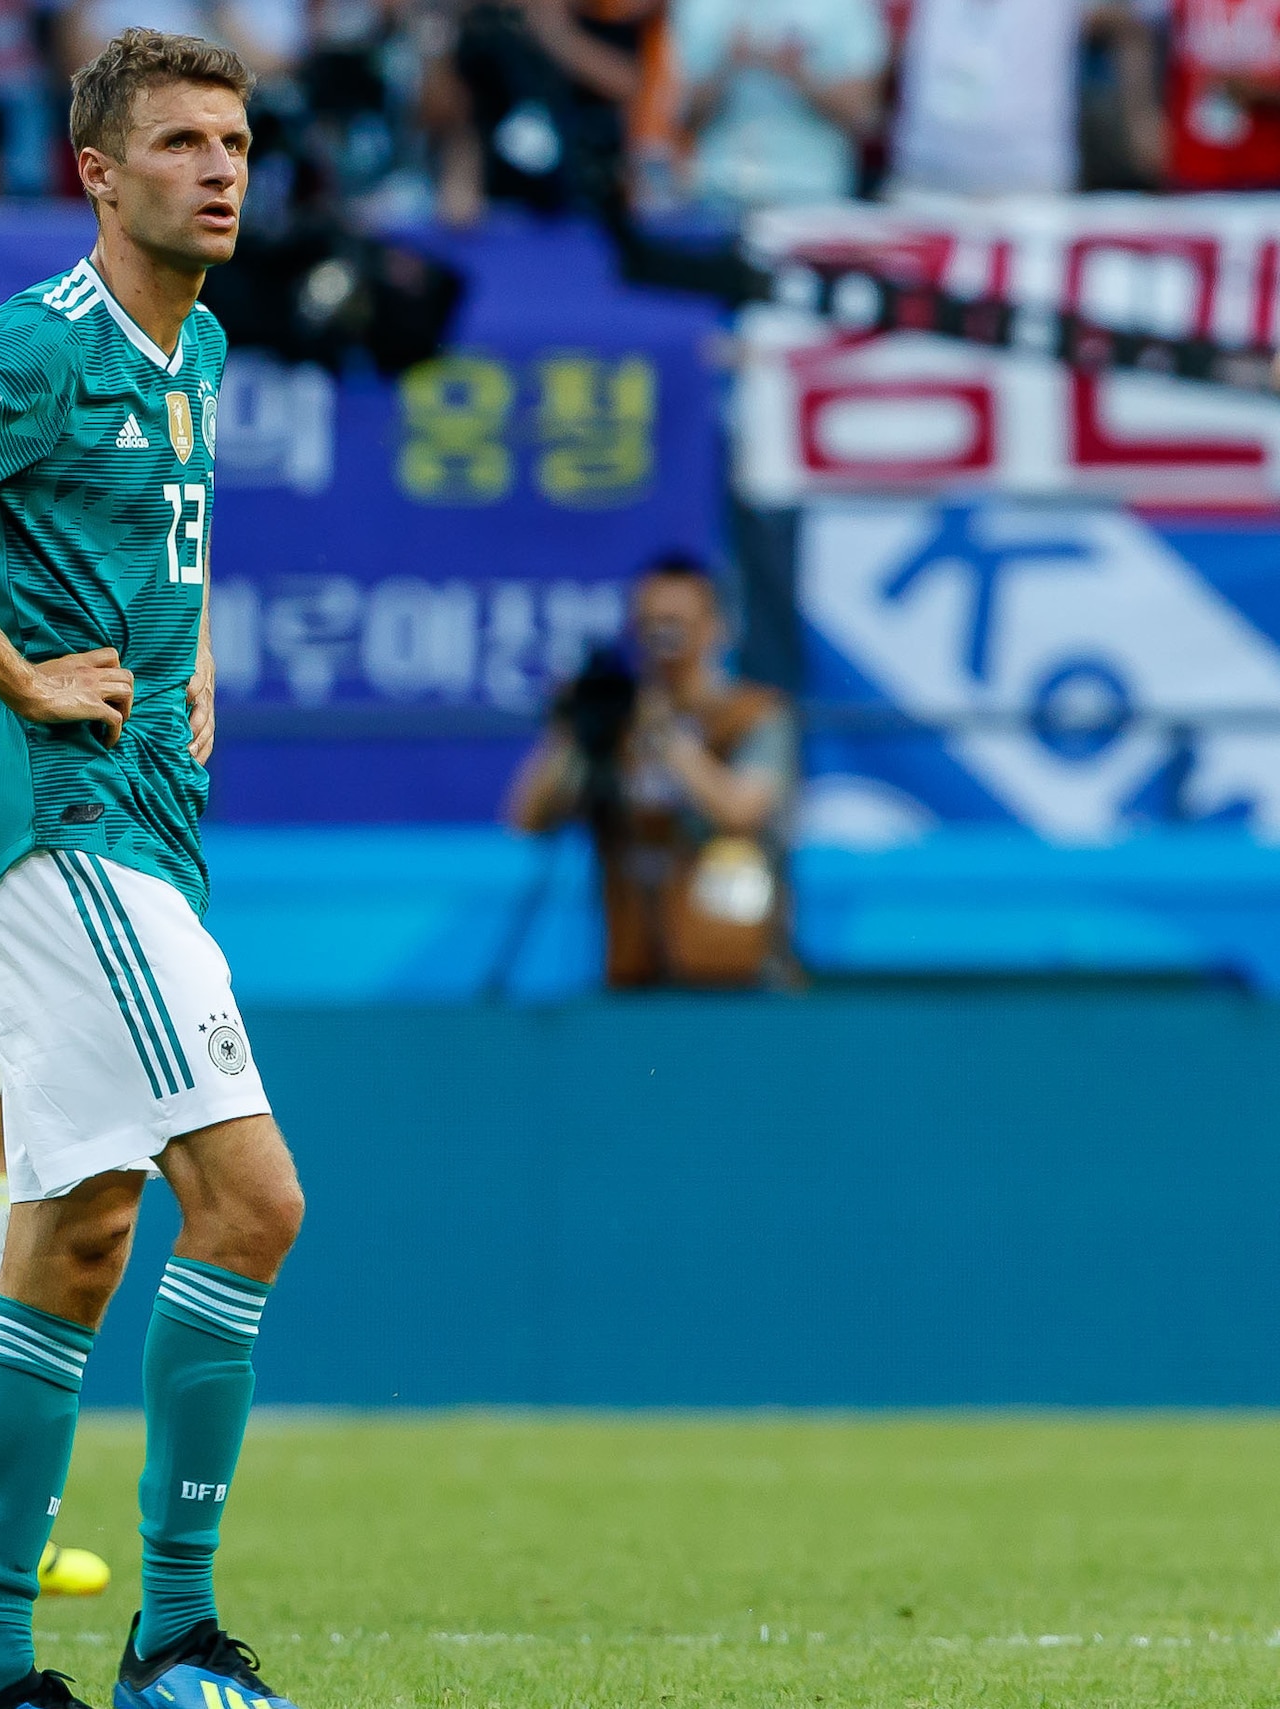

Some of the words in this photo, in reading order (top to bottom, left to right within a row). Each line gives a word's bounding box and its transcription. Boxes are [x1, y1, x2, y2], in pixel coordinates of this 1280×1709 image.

[115, 435, 150, 449] adidas
[163, 484, 206, 584] 13
[180, 1480, 228, 1503] DFB
